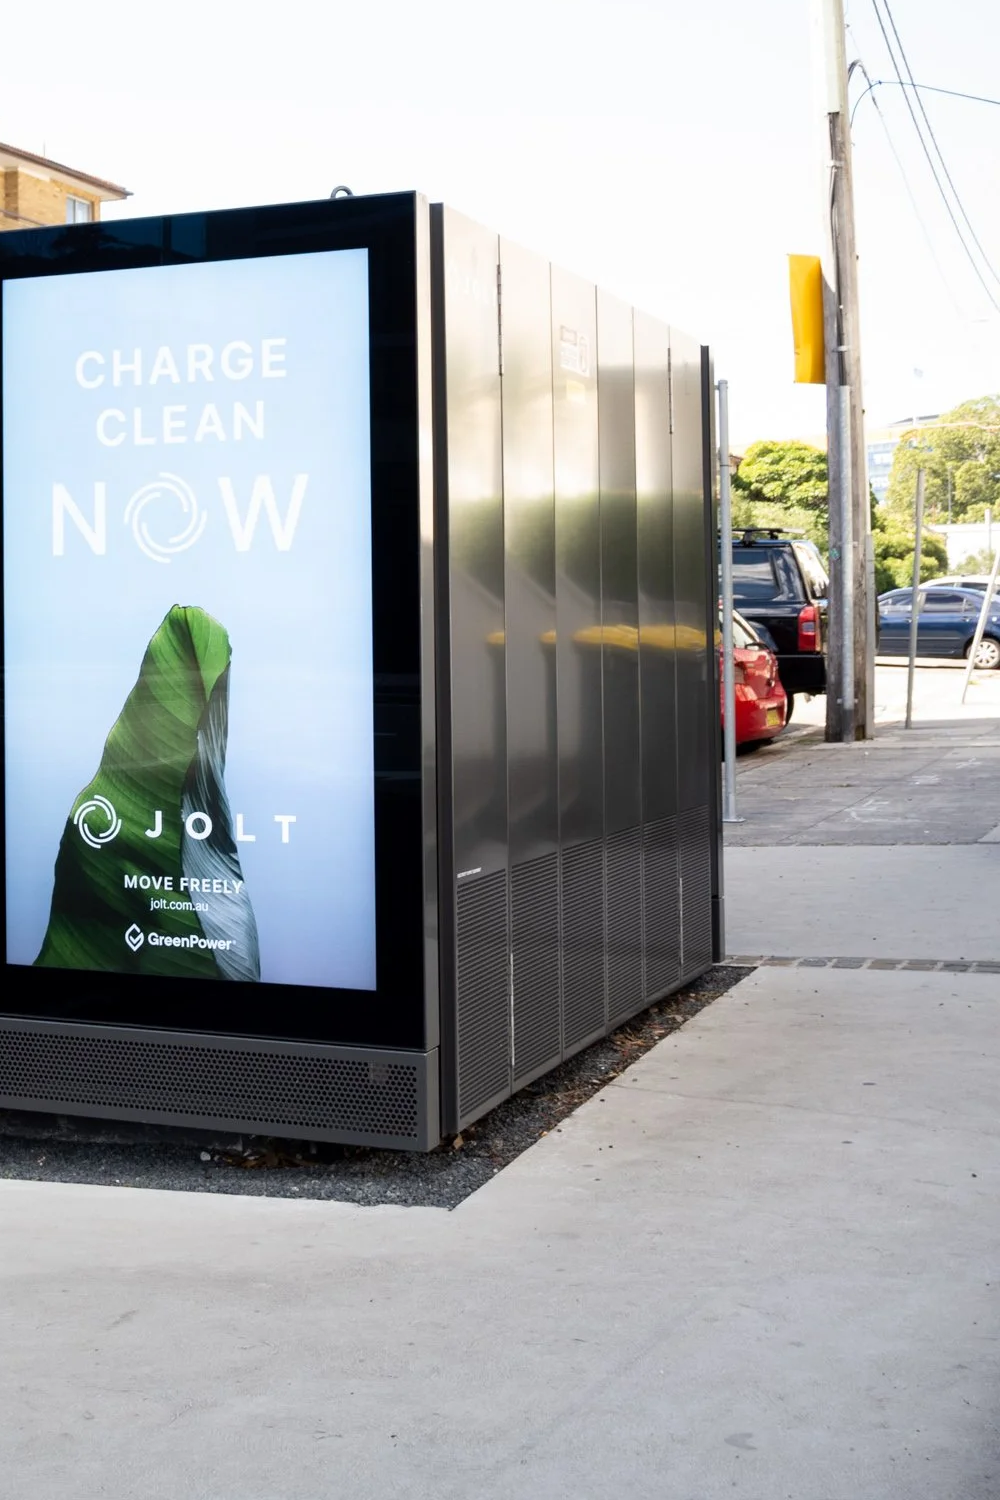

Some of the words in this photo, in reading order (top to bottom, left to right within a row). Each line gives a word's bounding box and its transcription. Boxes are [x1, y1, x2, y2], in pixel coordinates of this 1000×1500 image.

[74, 337, 288, 389] CHARGE
[96, 400, 264, 447] CLEAN
[144, 810, 297, 844] JOLT
[124, 874, 173, 891] MOVE
[179, 877, 244, 894] FREELY
[150, 897, 209, 912] jolt.com.au
[147, 932, 232, 950] GreenPower
